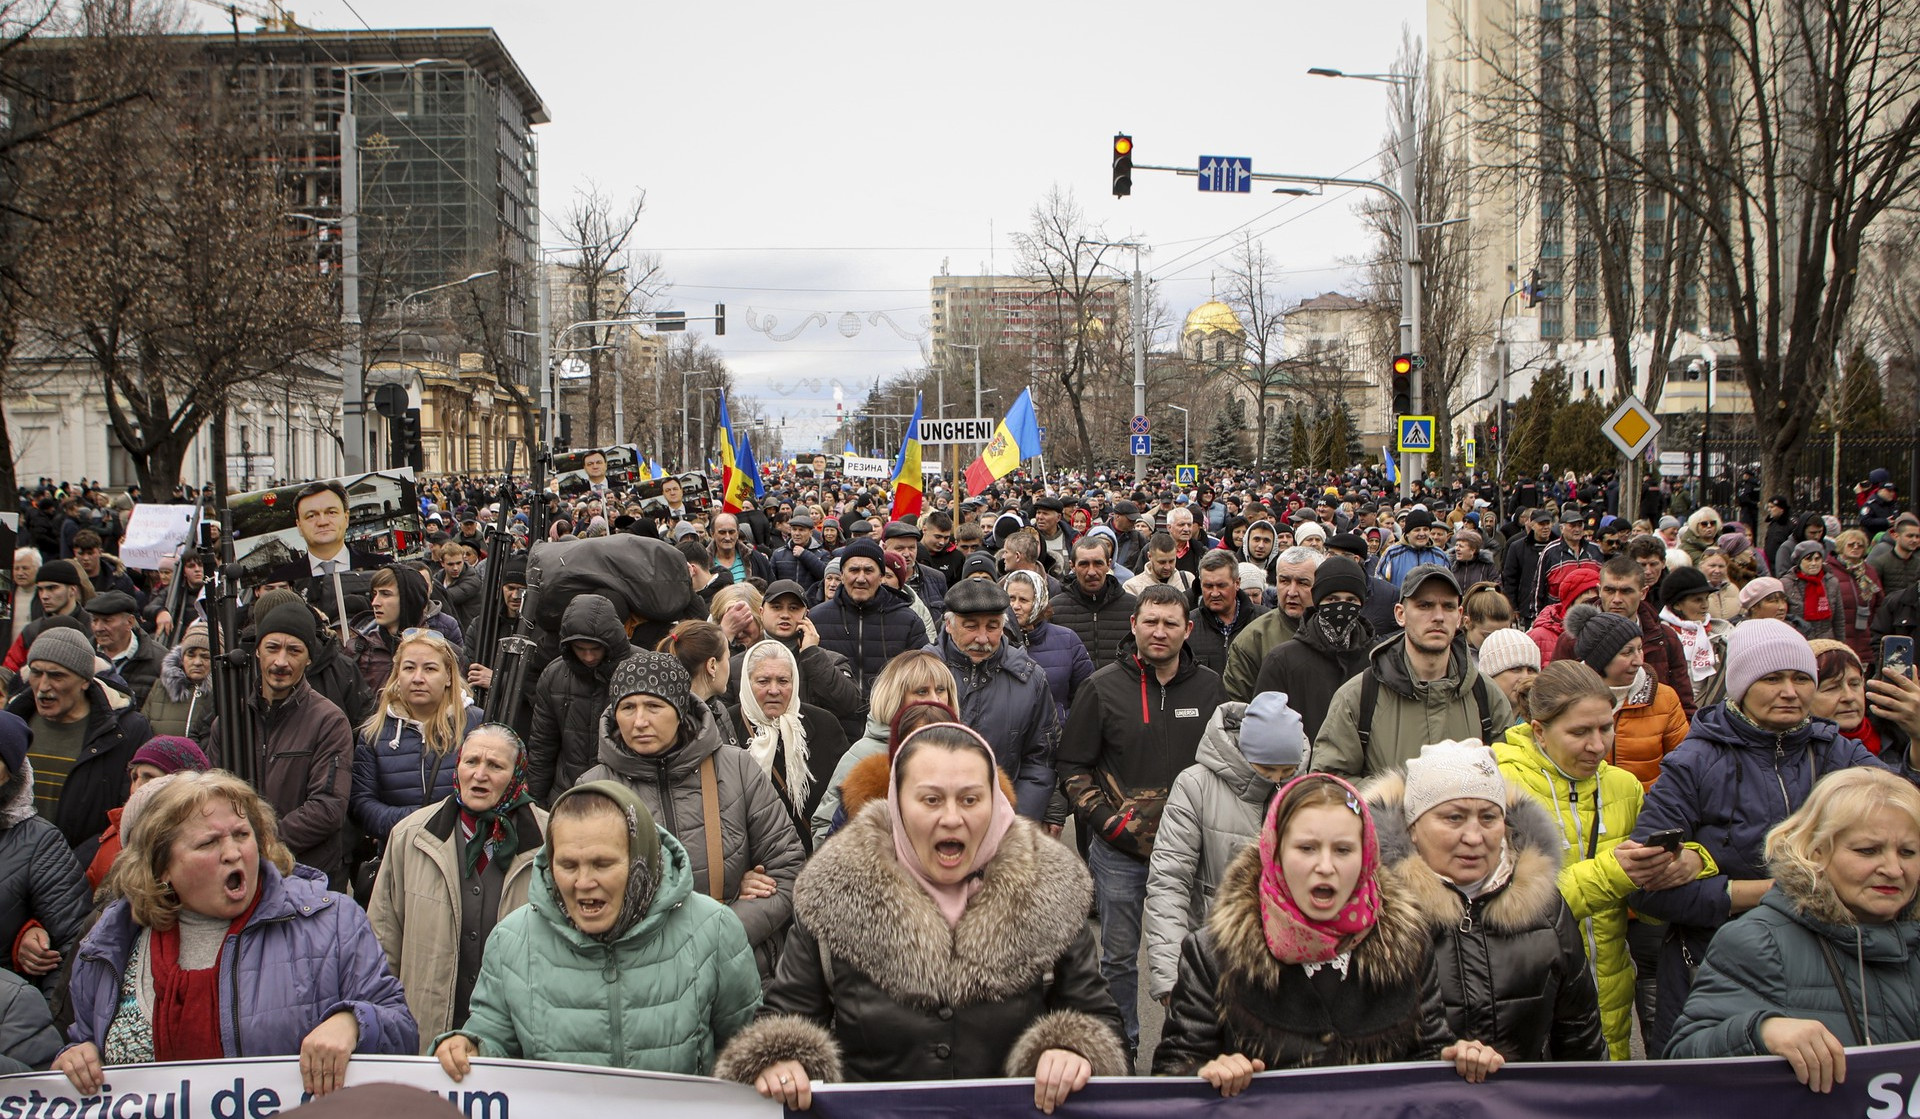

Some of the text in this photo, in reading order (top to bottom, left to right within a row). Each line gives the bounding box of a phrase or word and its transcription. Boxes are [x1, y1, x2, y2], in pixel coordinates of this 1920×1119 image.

[921, 421, 991, 441] UNGHENI
[847, 462, 883, 473] РЕЗИНА
[211, 1077, 281, 1119] de
